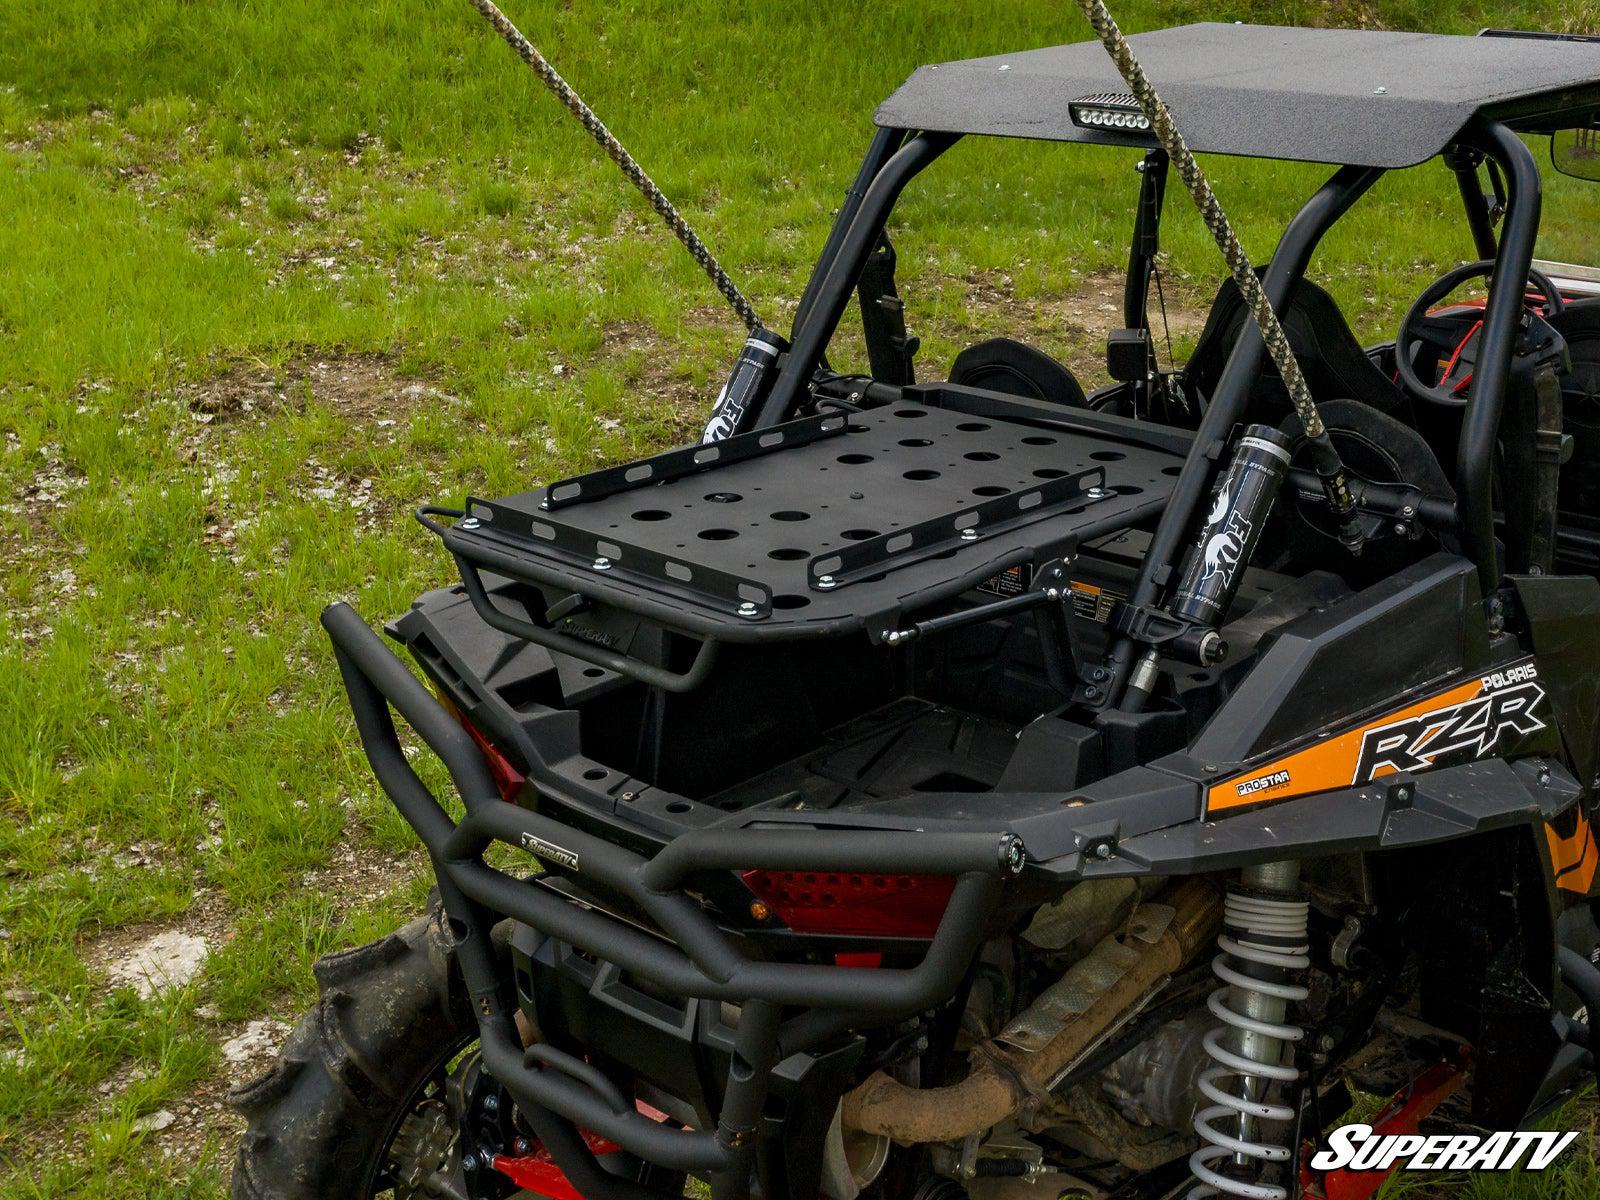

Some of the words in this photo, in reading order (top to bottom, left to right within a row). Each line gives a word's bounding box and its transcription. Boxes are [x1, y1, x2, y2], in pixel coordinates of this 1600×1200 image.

[703, 397, 744, 445] FO
[1203, 510, 1253, 590] FOX
[1482, 663, 1538, 692] POLARIS
[1352, 683, 1546, 785] RZR
[1237, 771, 1290, 795] PROSTAR
